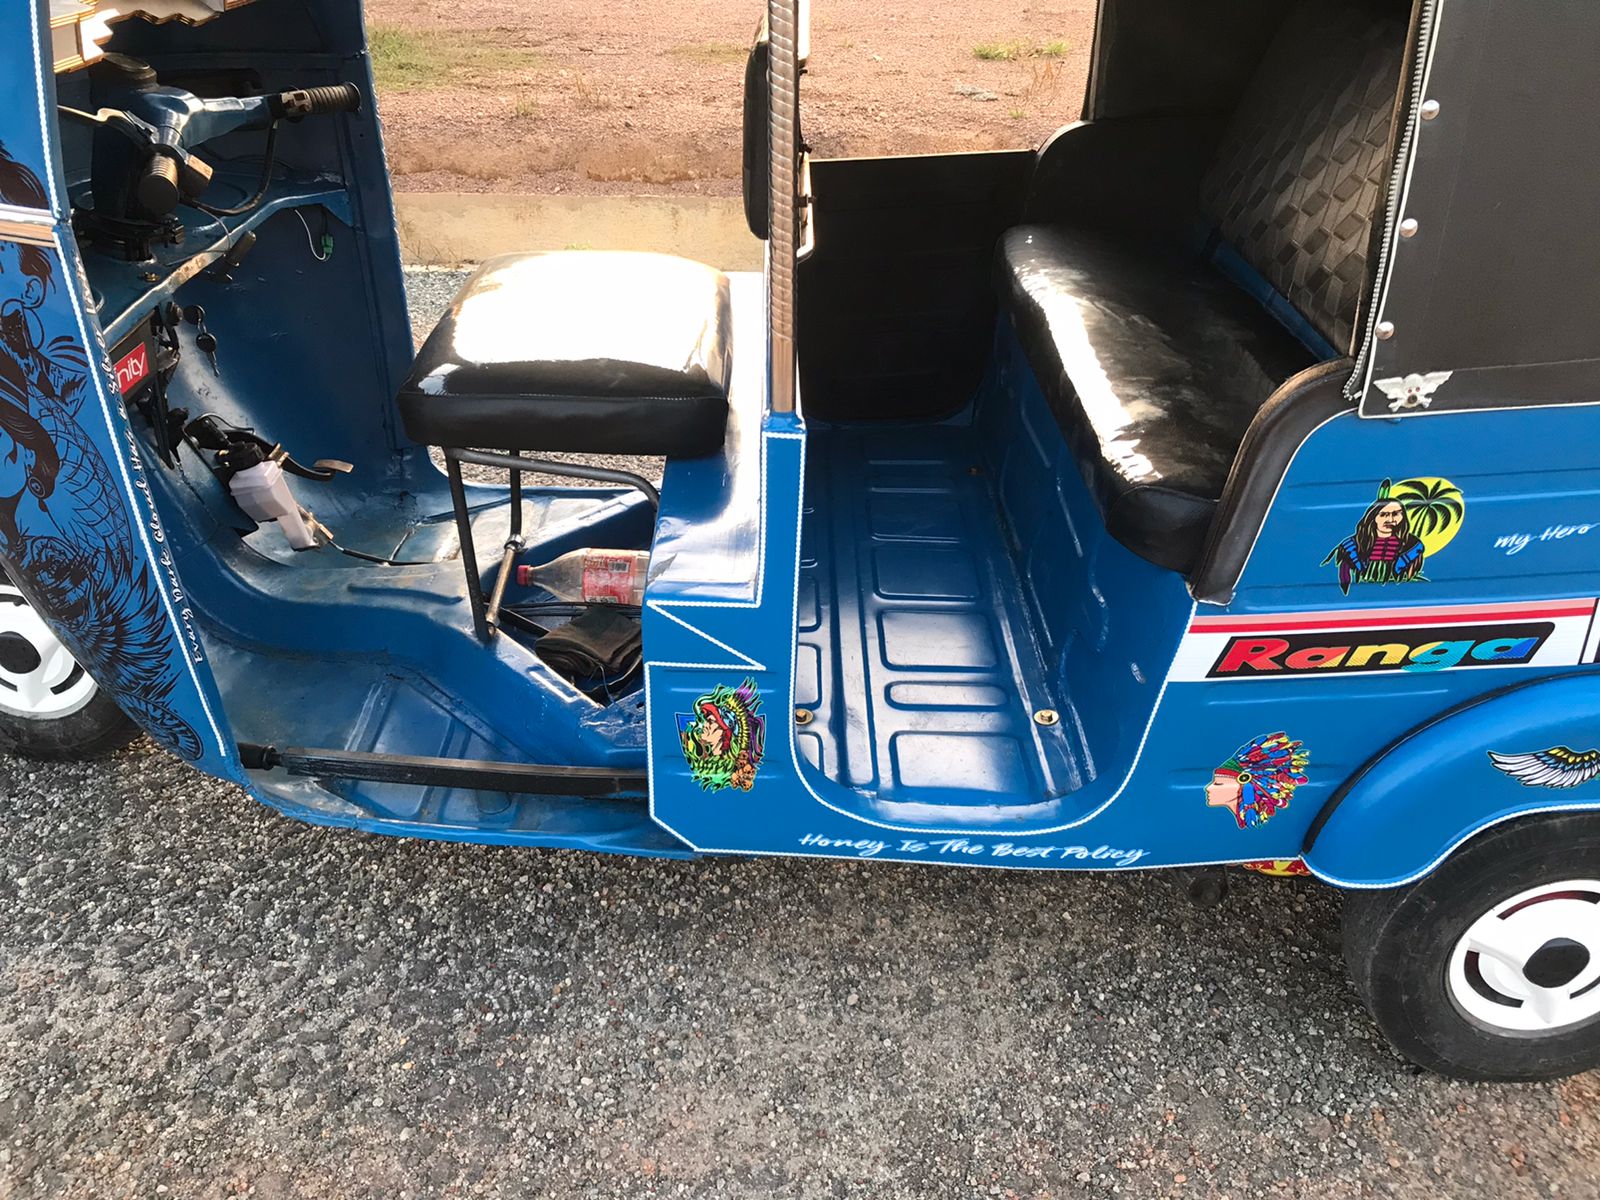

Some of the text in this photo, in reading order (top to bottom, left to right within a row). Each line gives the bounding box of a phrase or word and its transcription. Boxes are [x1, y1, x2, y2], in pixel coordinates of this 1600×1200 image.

[125, 428, 143, 472] Has
[136, 478, 164, 543] Cloud
[1539, 522, 1599, 541] Hero
[160, 549, 184, 602] Dark
[1216, 637, 1539, 673] Ranga
[798, 833, 1151, 867] Honey Is The Best Policy
